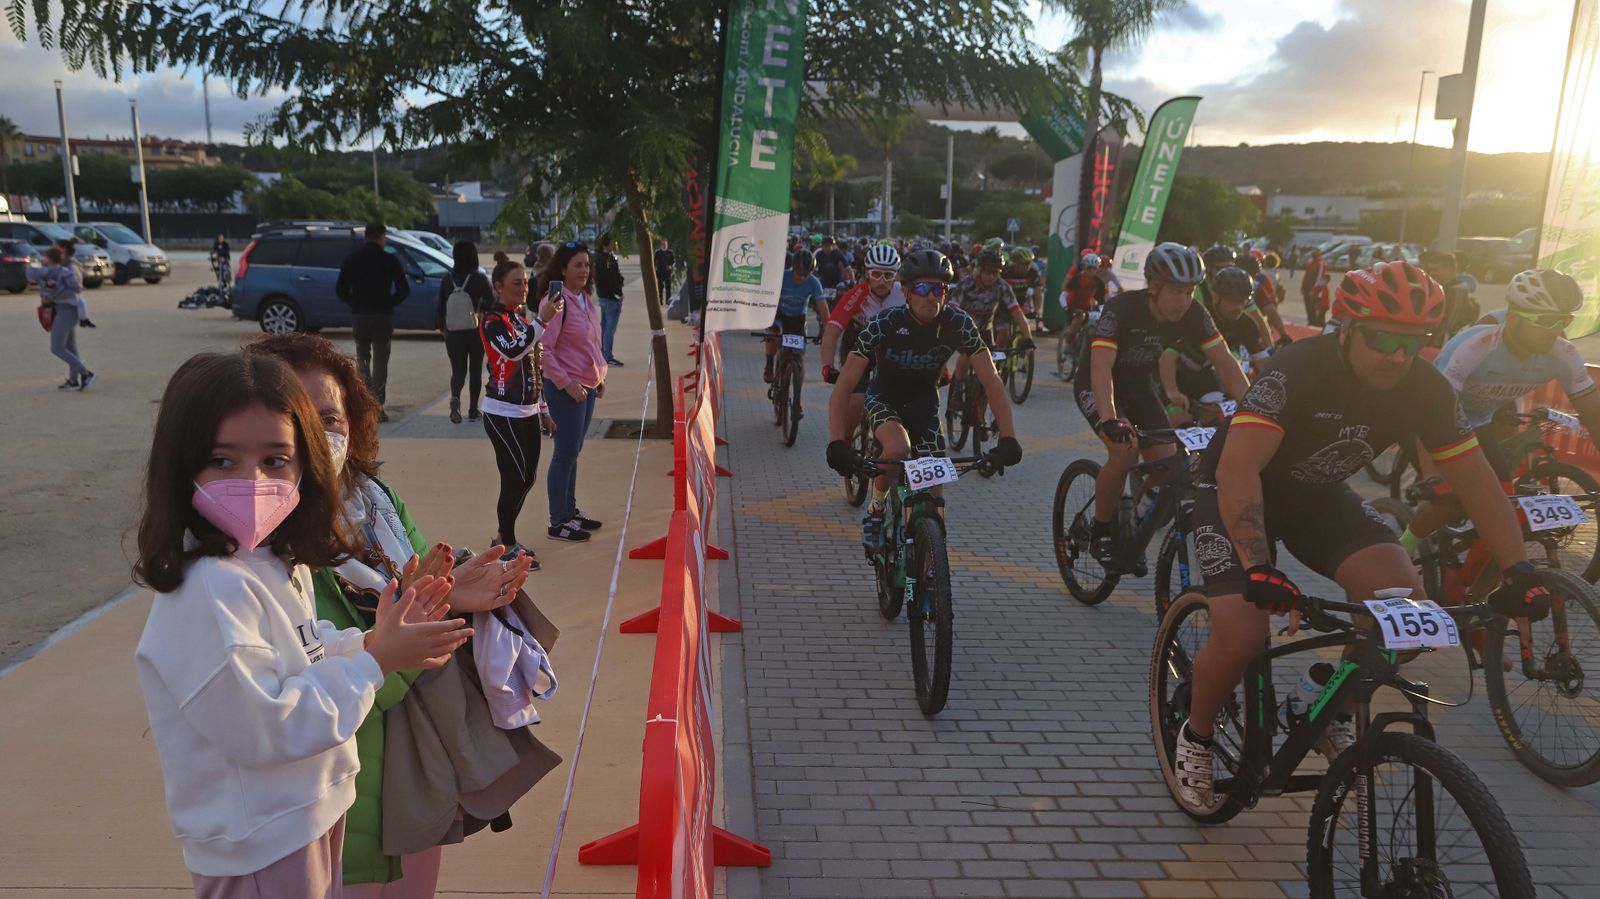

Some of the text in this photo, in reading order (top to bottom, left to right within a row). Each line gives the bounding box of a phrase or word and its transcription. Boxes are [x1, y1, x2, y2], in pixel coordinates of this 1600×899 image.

[728, 68, 749, 167] ANDALUCIA
[1141, 117, 1185, 224] ÚNETE
[911, 465, 946, 484] 358
[1530, 506, 1572, 524] 349
[1383, 612, 1439, 637] 155
